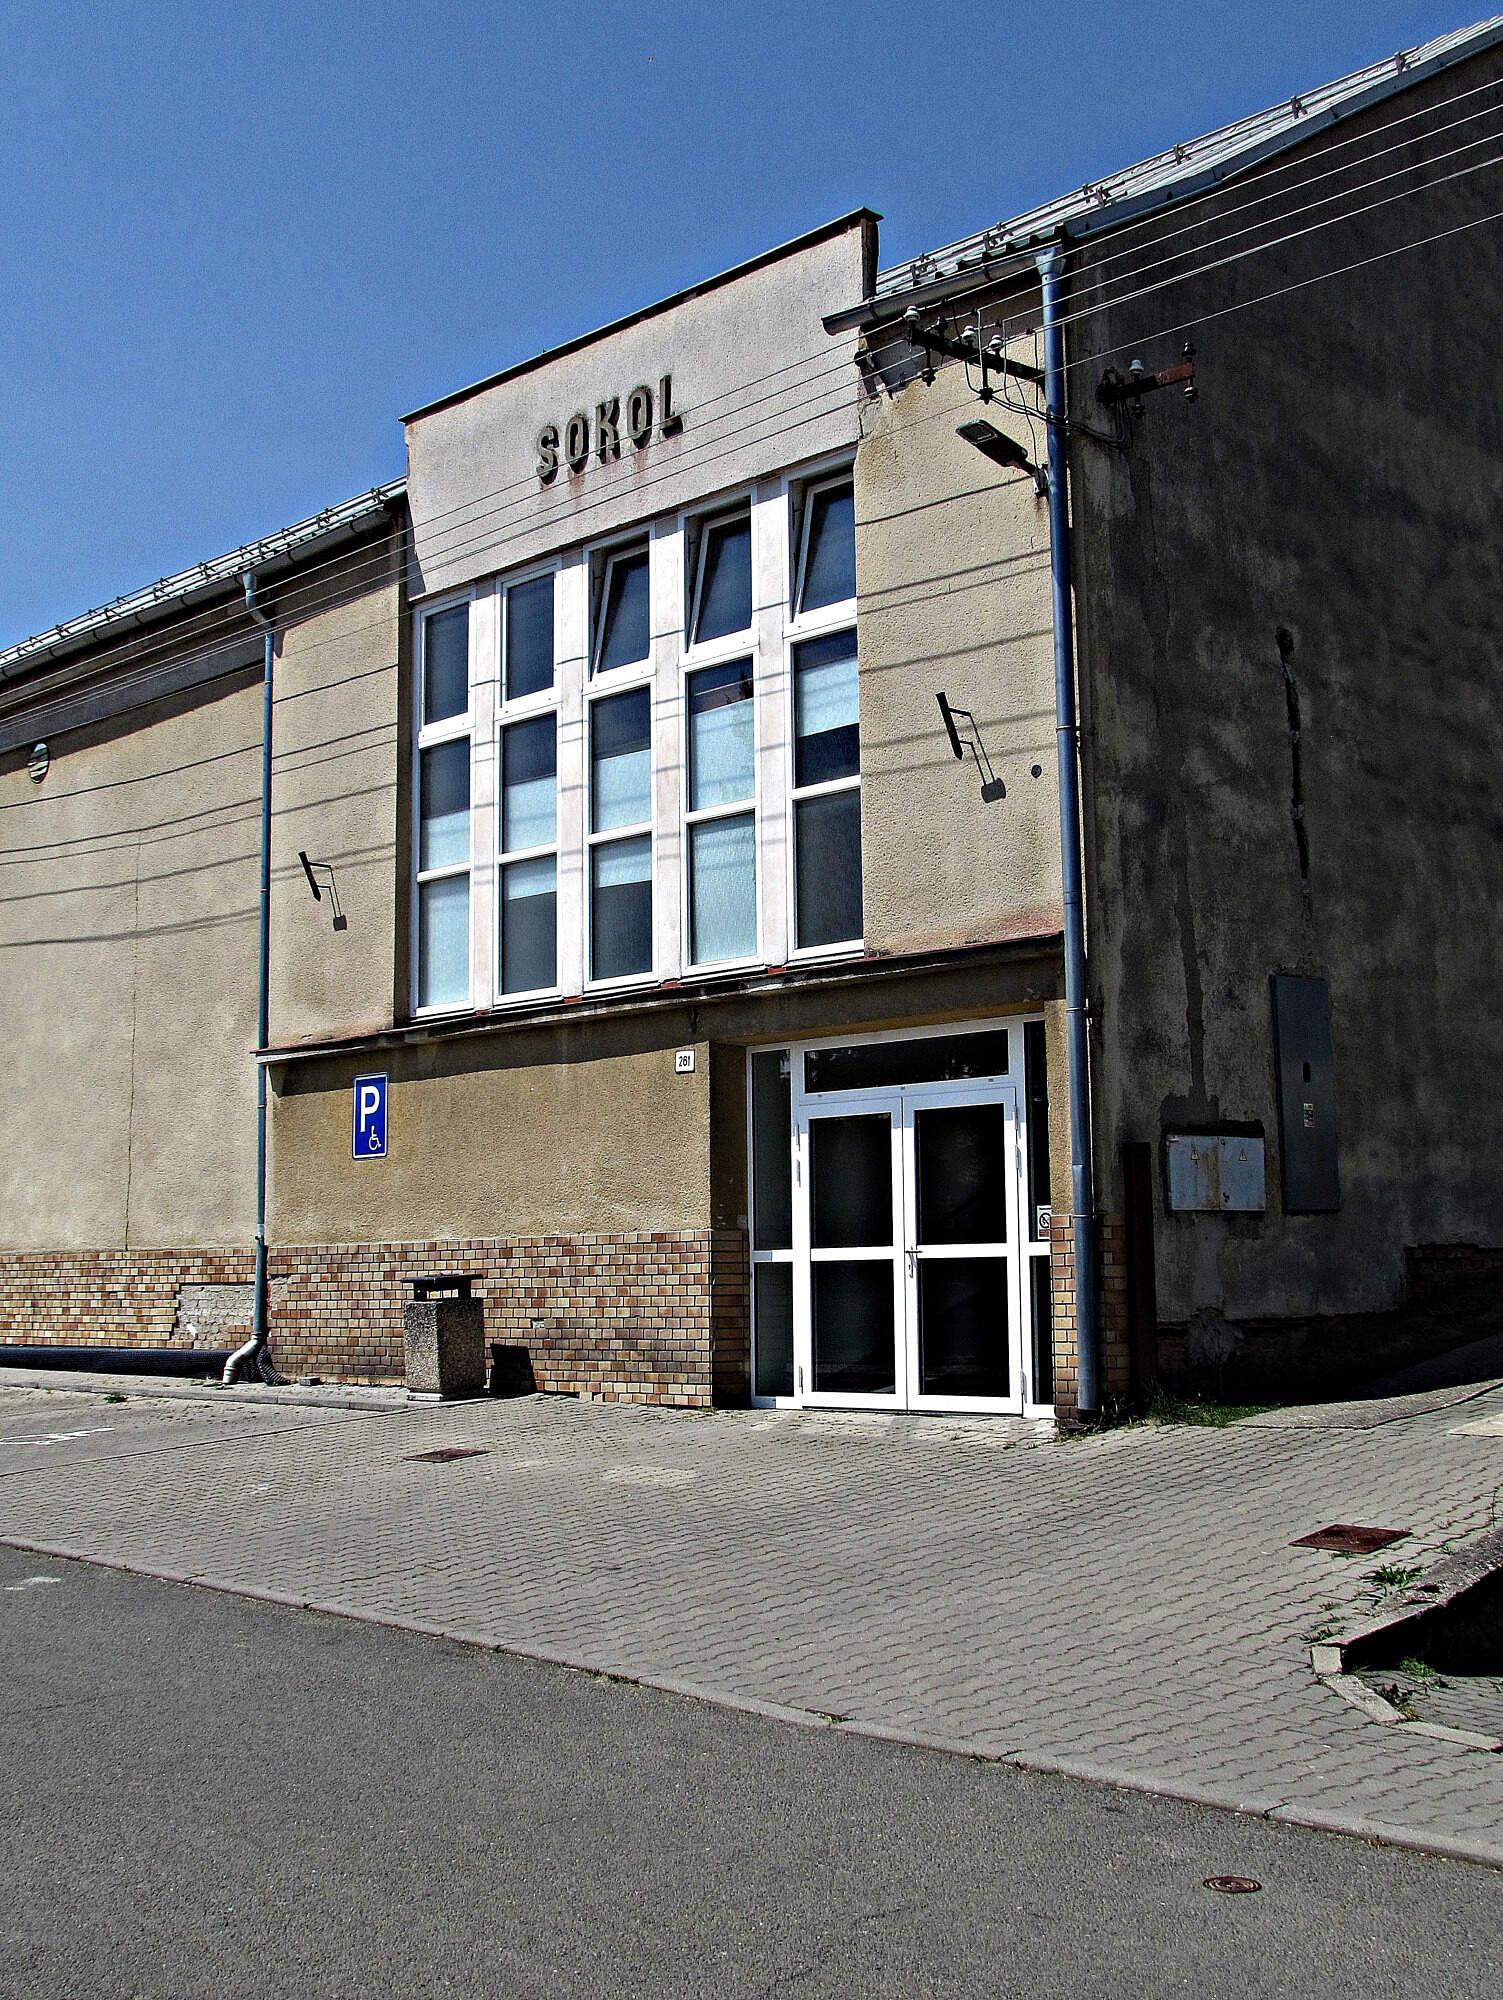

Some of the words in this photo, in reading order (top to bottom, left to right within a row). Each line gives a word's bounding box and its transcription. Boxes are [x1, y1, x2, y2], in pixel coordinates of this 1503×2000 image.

[536, 375, 684, 486] SOKOL
[678, 1055, 691, 1068] 261
[360, 1085, 380, 1133] P
